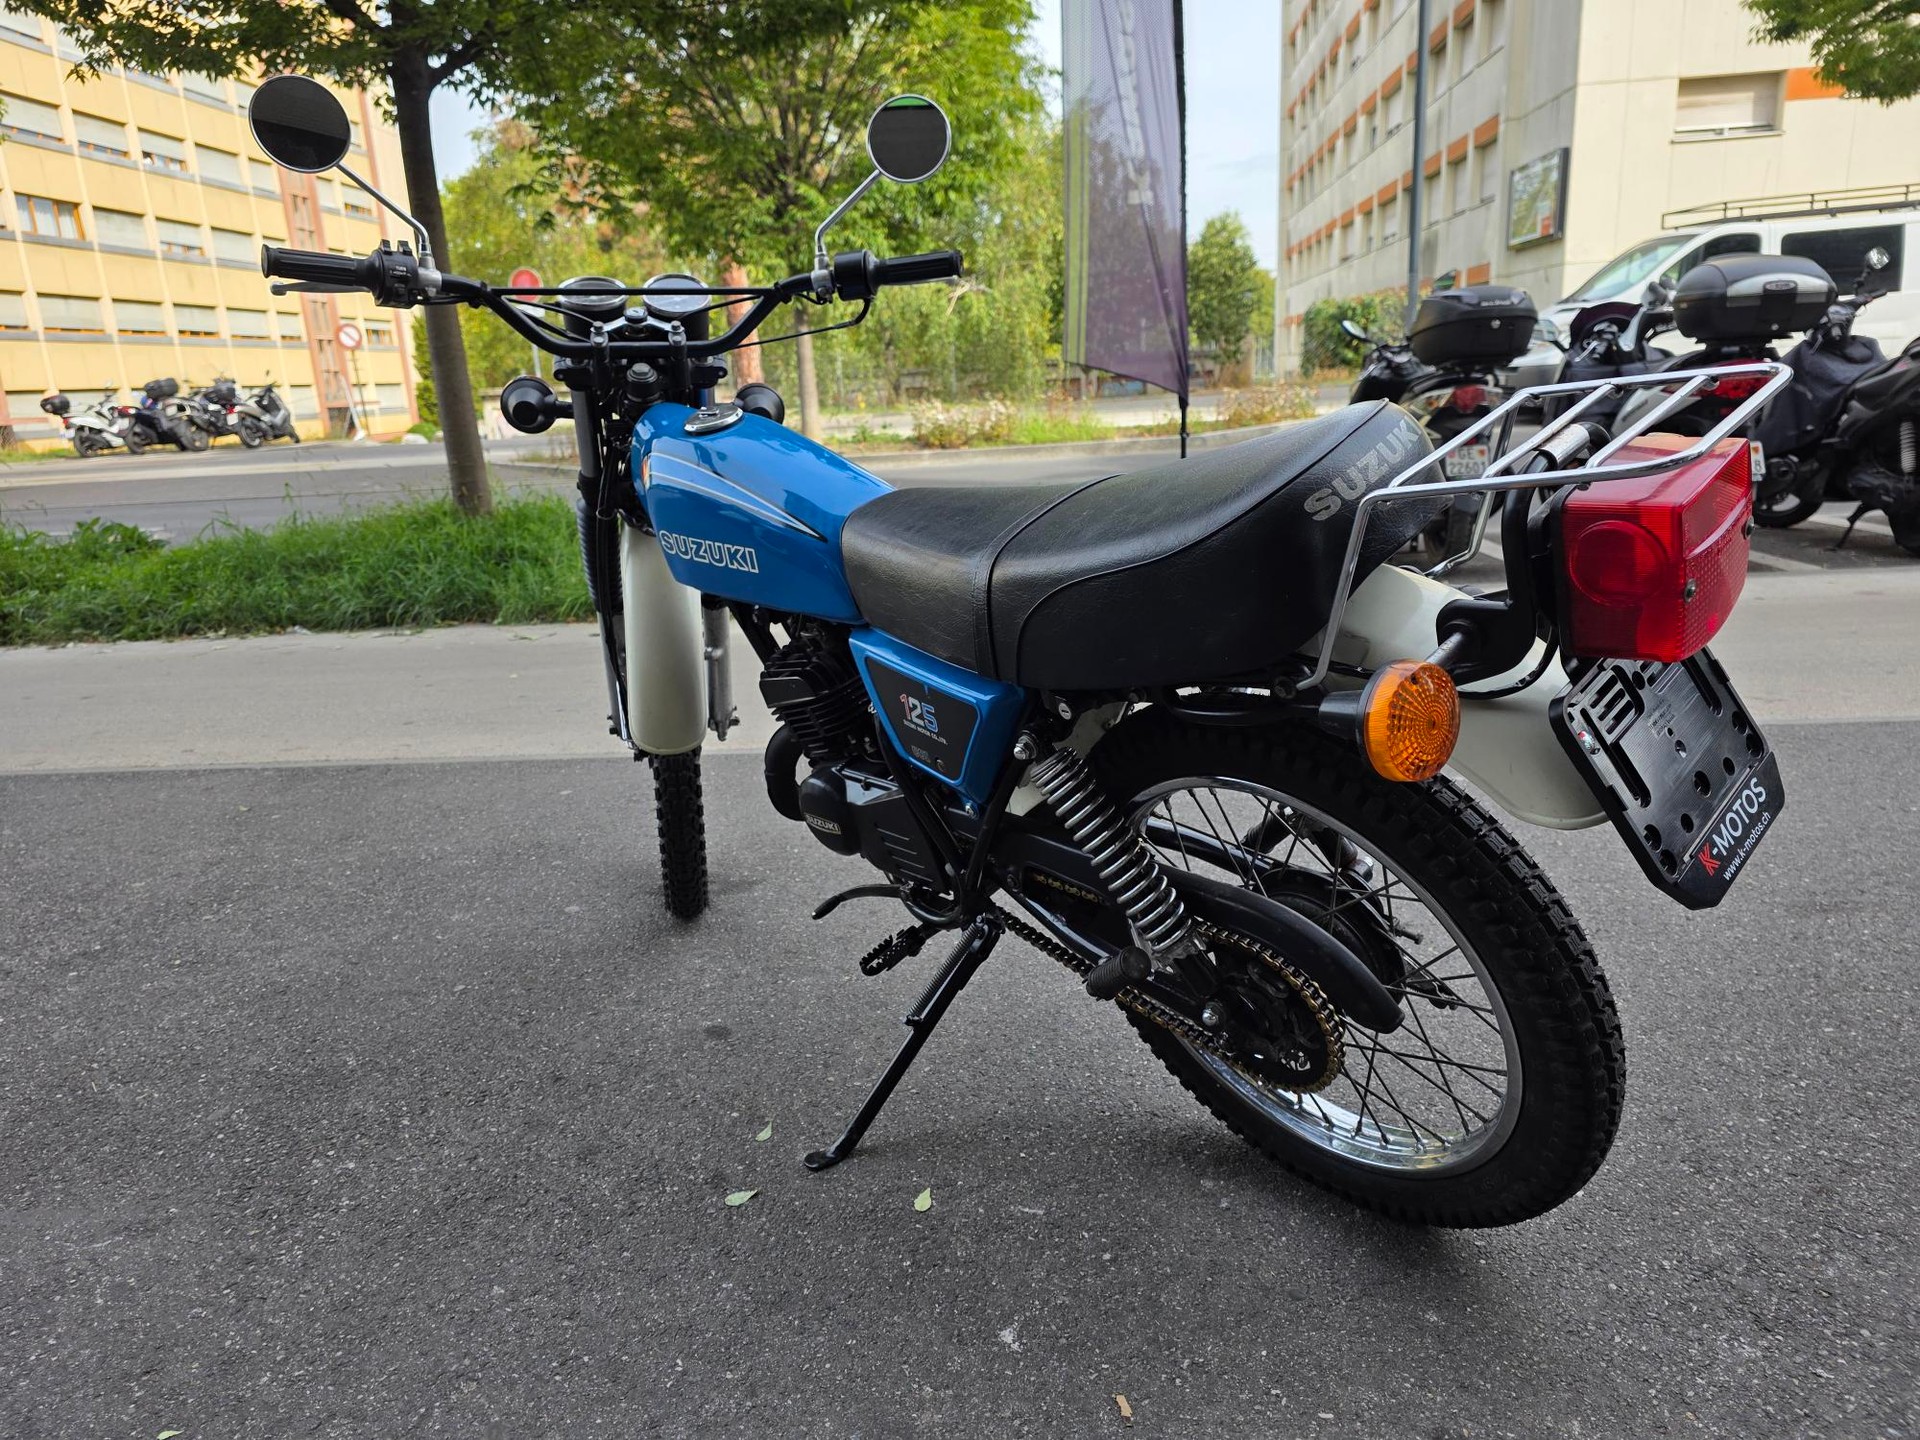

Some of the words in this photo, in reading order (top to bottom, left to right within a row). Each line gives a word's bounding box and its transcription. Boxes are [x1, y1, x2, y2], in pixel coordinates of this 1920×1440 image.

[1458, 447, 1475, 460] GE
[660, 530, 759, 573] SUZUKI
[900, 694, 939, 733] 125
[1698, 777, 1766, 876] K-MOTOS
[1723, 811, 1771, 881] www.k-motos.ch
